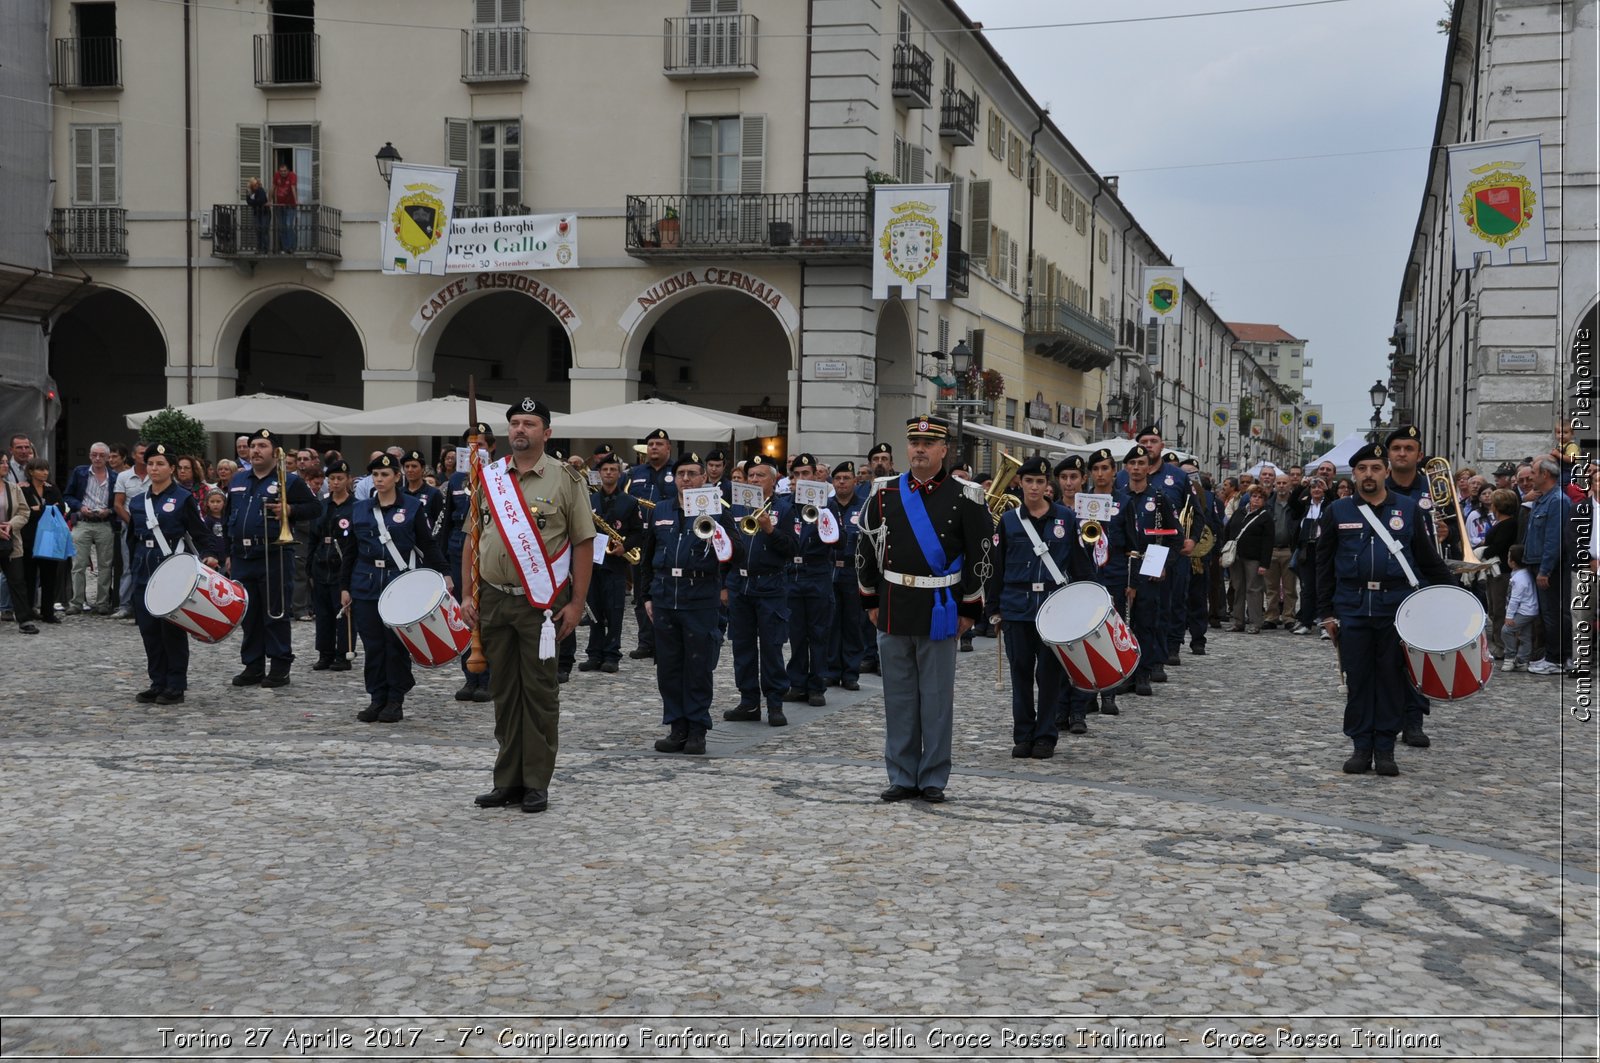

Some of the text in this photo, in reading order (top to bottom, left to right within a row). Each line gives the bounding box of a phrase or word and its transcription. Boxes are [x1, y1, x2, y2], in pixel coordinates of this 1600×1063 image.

[471, 222, 489, 234] dei
[493, 219, 534, 235] Borghi
[446, 262, 476, 270] omenica
[479, 259, 490, 269] 30
[494, 260, 529, 269] Settembre
[447, 236, 547, 260] orgo Gallo
[475, 271, 576, 325] RISTORANTE
[637, 267, 783, 312] NUOVA CERNAIA
[494, 472, 540, 574] INTER ARMA CARITAS
